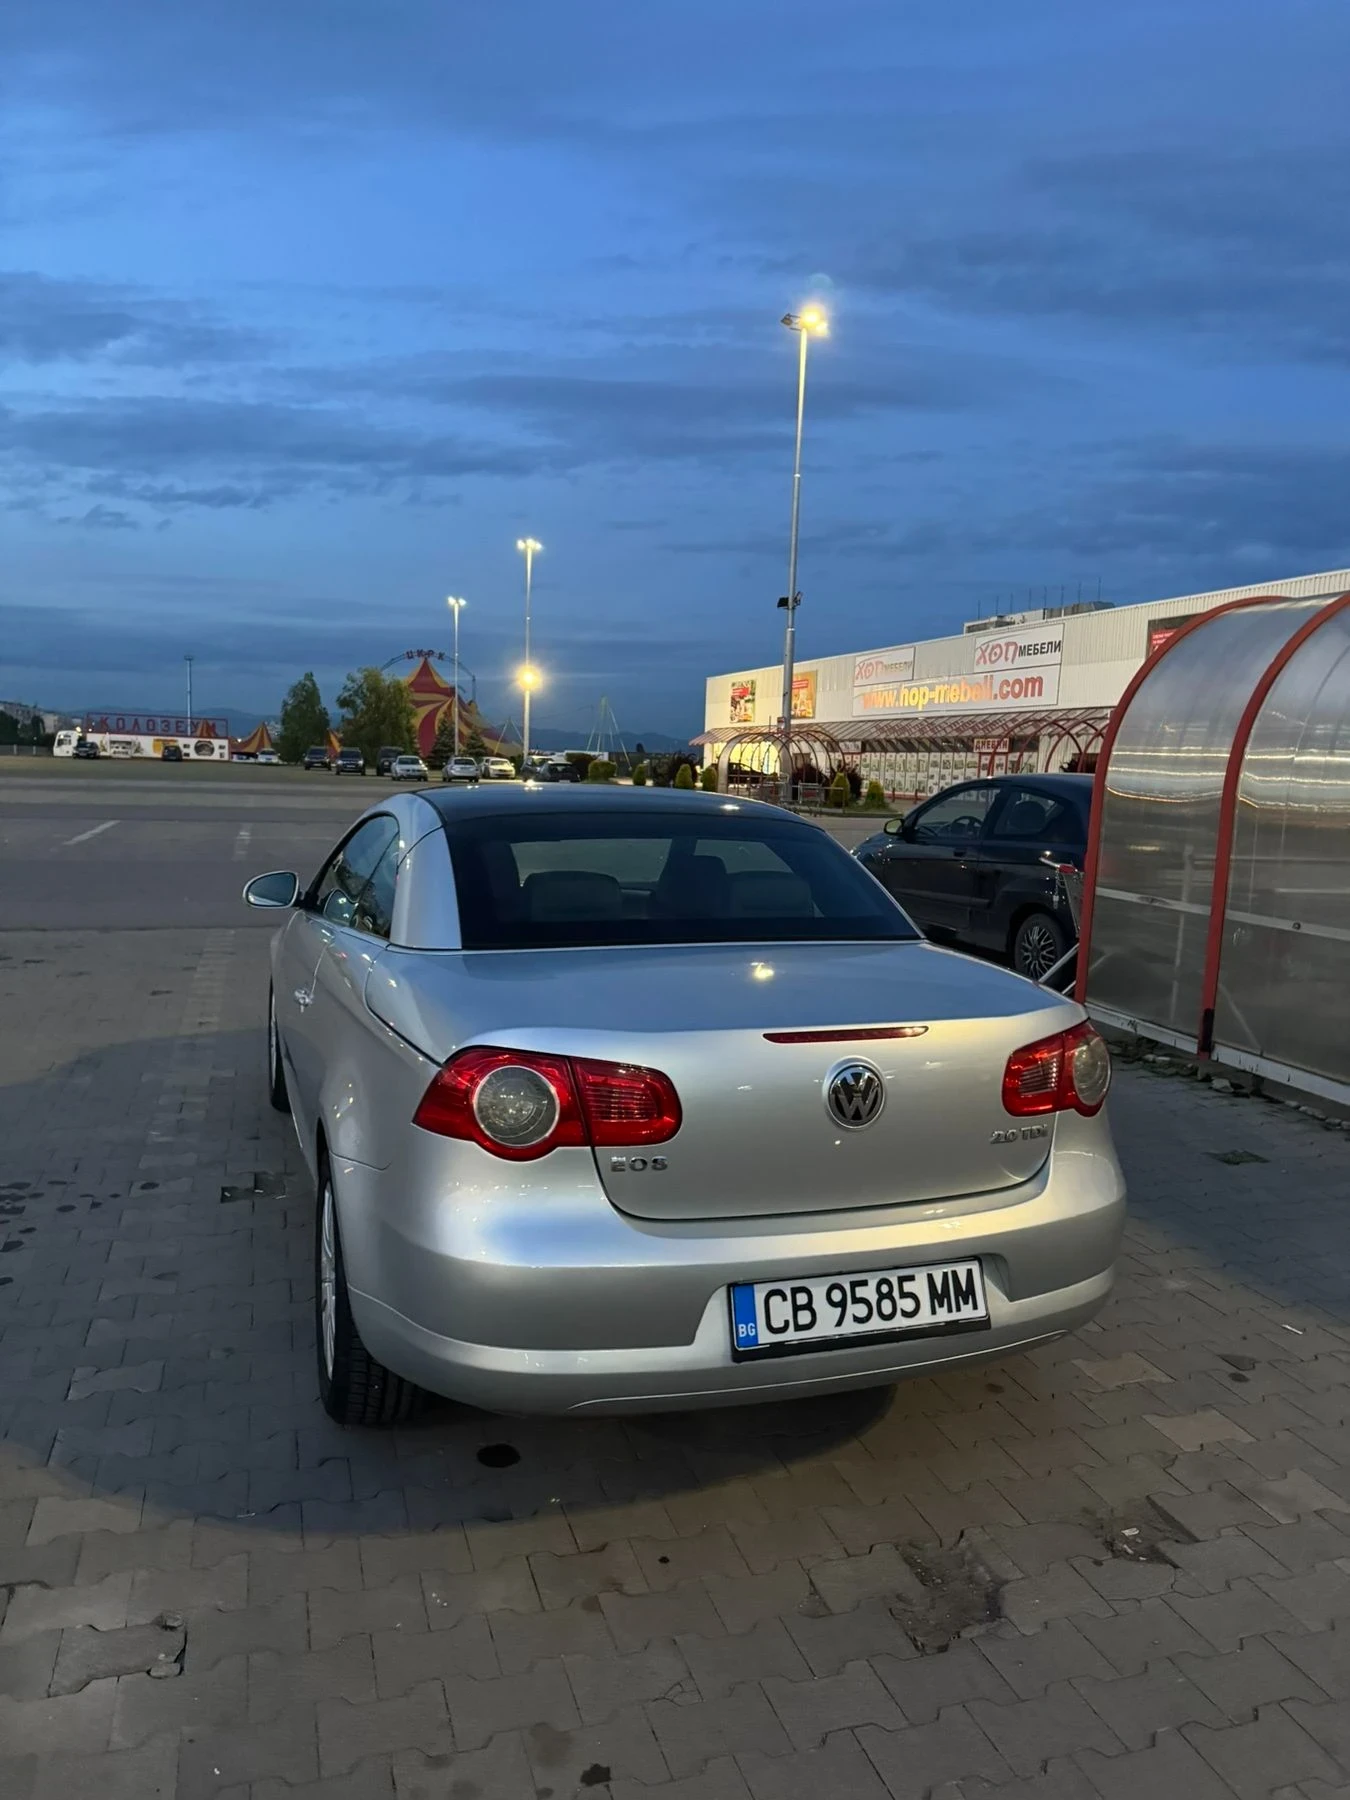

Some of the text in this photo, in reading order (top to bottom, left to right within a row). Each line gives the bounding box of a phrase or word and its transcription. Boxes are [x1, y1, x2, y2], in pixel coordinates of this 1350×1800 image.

[1018, 640, 1061, 657] МЕБЕЛИ
[862, 674, 1044, 710] www.hop-mebeli.com
[764, 1268, 979, 1334] CB 9585 MM
[738, 1323, 756, 1338] BG
